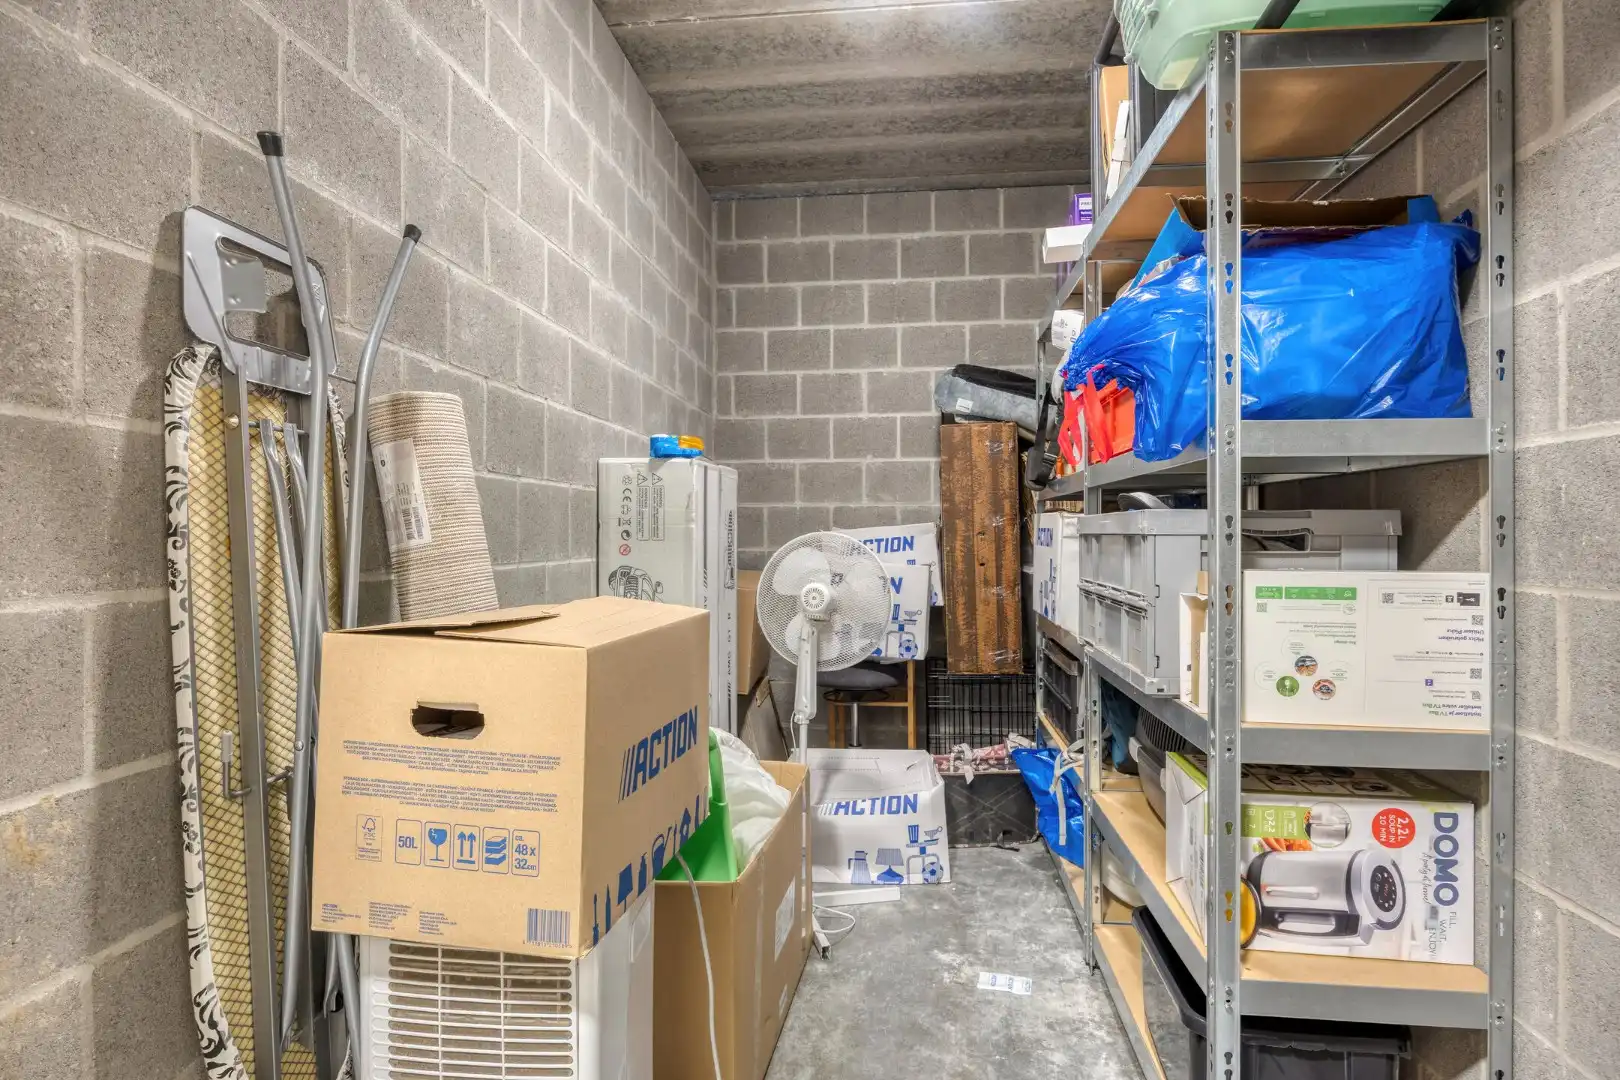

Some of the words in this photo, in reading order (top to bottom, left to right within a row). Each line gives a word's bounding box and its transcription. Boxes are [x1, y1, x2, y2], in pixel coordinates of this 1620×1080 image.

[858, 535, 914, 553] CTION
[631, 705, 698, 793] ACTION
[834, 793, 918, 816] ACTION
[1379, 815, 1387, 825] 20
[1388, 814, 1396, 833] SOUP
[398, 836, 418, 849] 50L
[1379, 827, 1387, 842] MIN
[1388, 835, 1396, 843] IN
[515, 843, 528, 856] 48
[1433, 811, 1459, 907] DOMO
